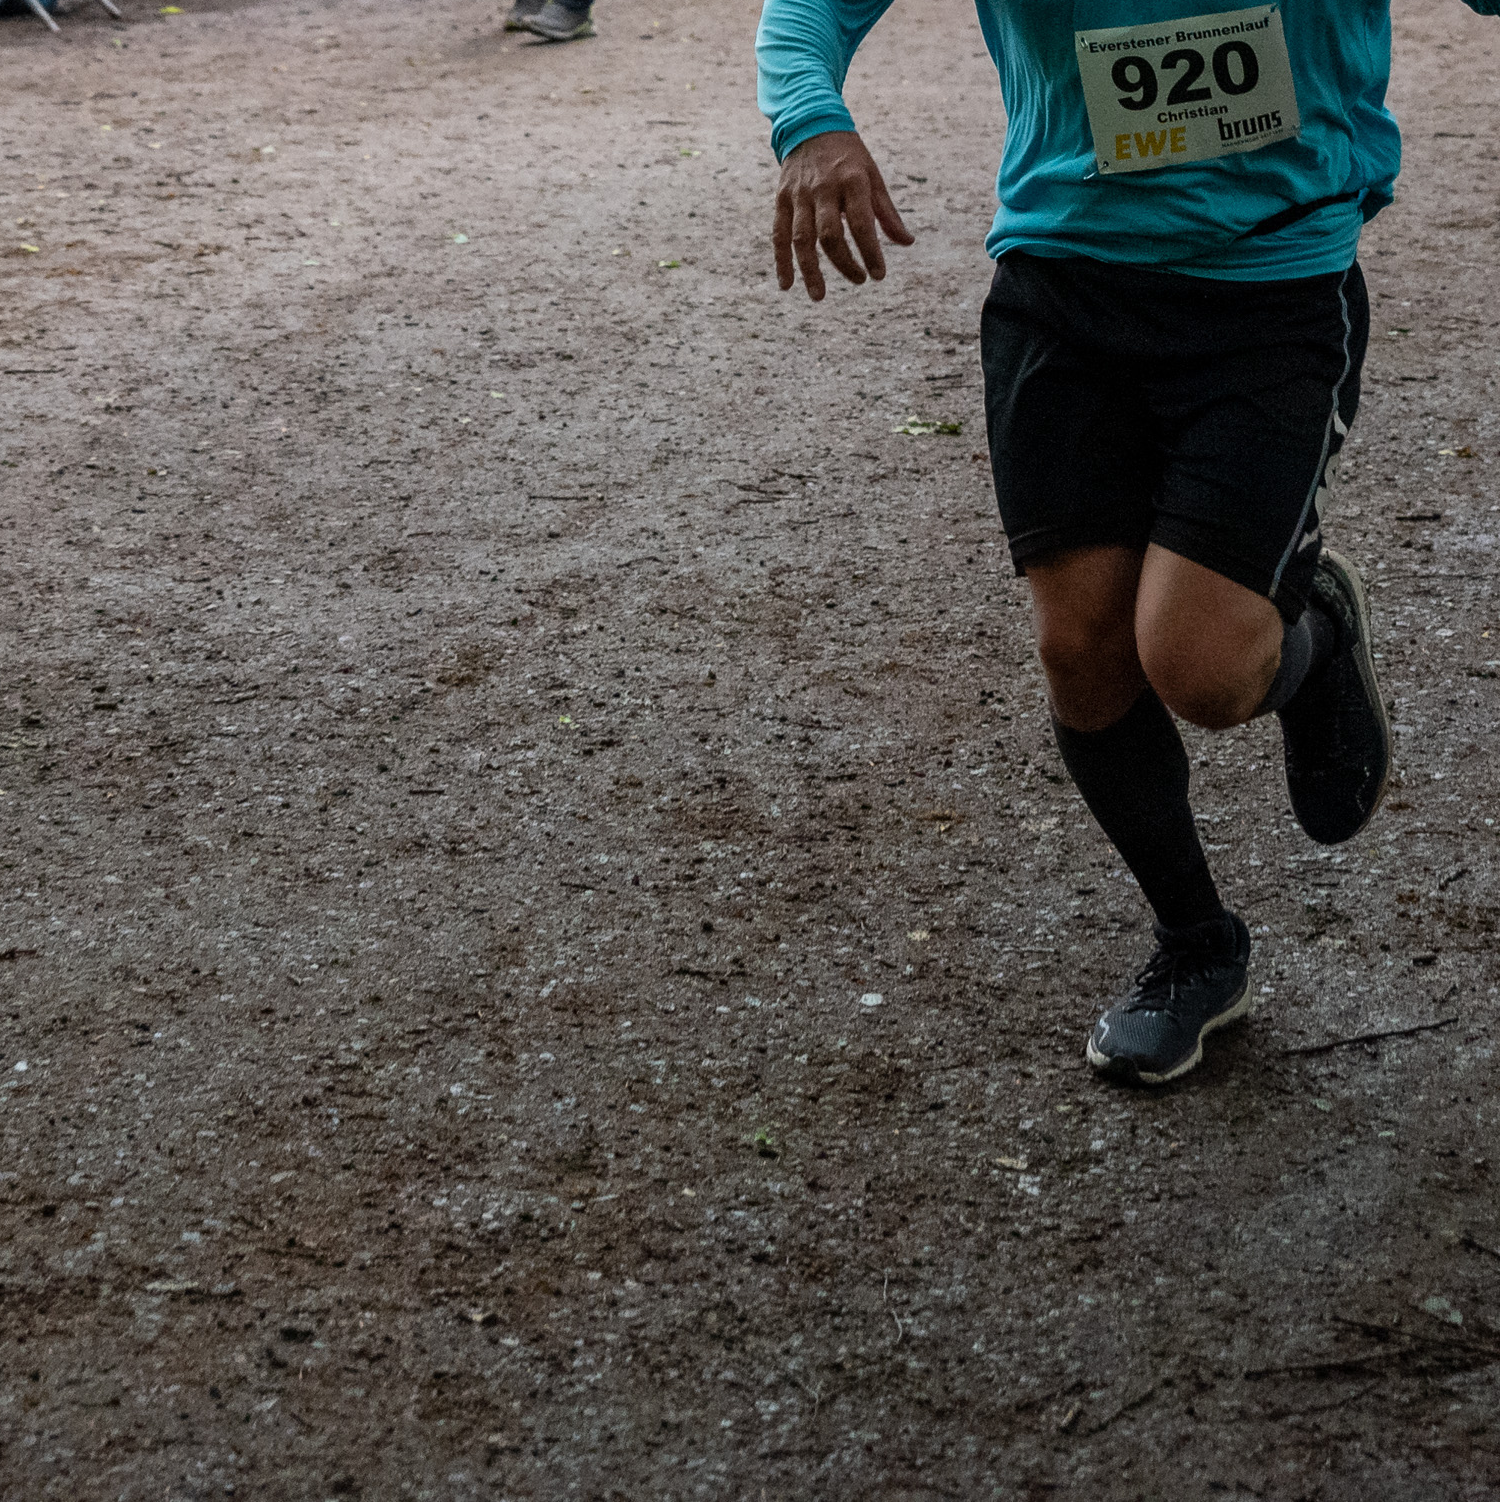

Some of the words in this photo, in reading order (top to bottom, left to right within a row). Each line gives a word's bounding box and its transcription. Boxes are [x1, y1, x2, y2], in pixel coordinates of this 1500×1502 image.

[1089, 35, 1172, 54] Everstener
[1175, 16, 1270, 43] Brunnenlauf
[1111, 40, 1259, 111] 920
[1157, 104, 1228, 124] Christian
[1216, 110, 1282, 141] bruns
[1115, 126, 1187, 161] EWE
